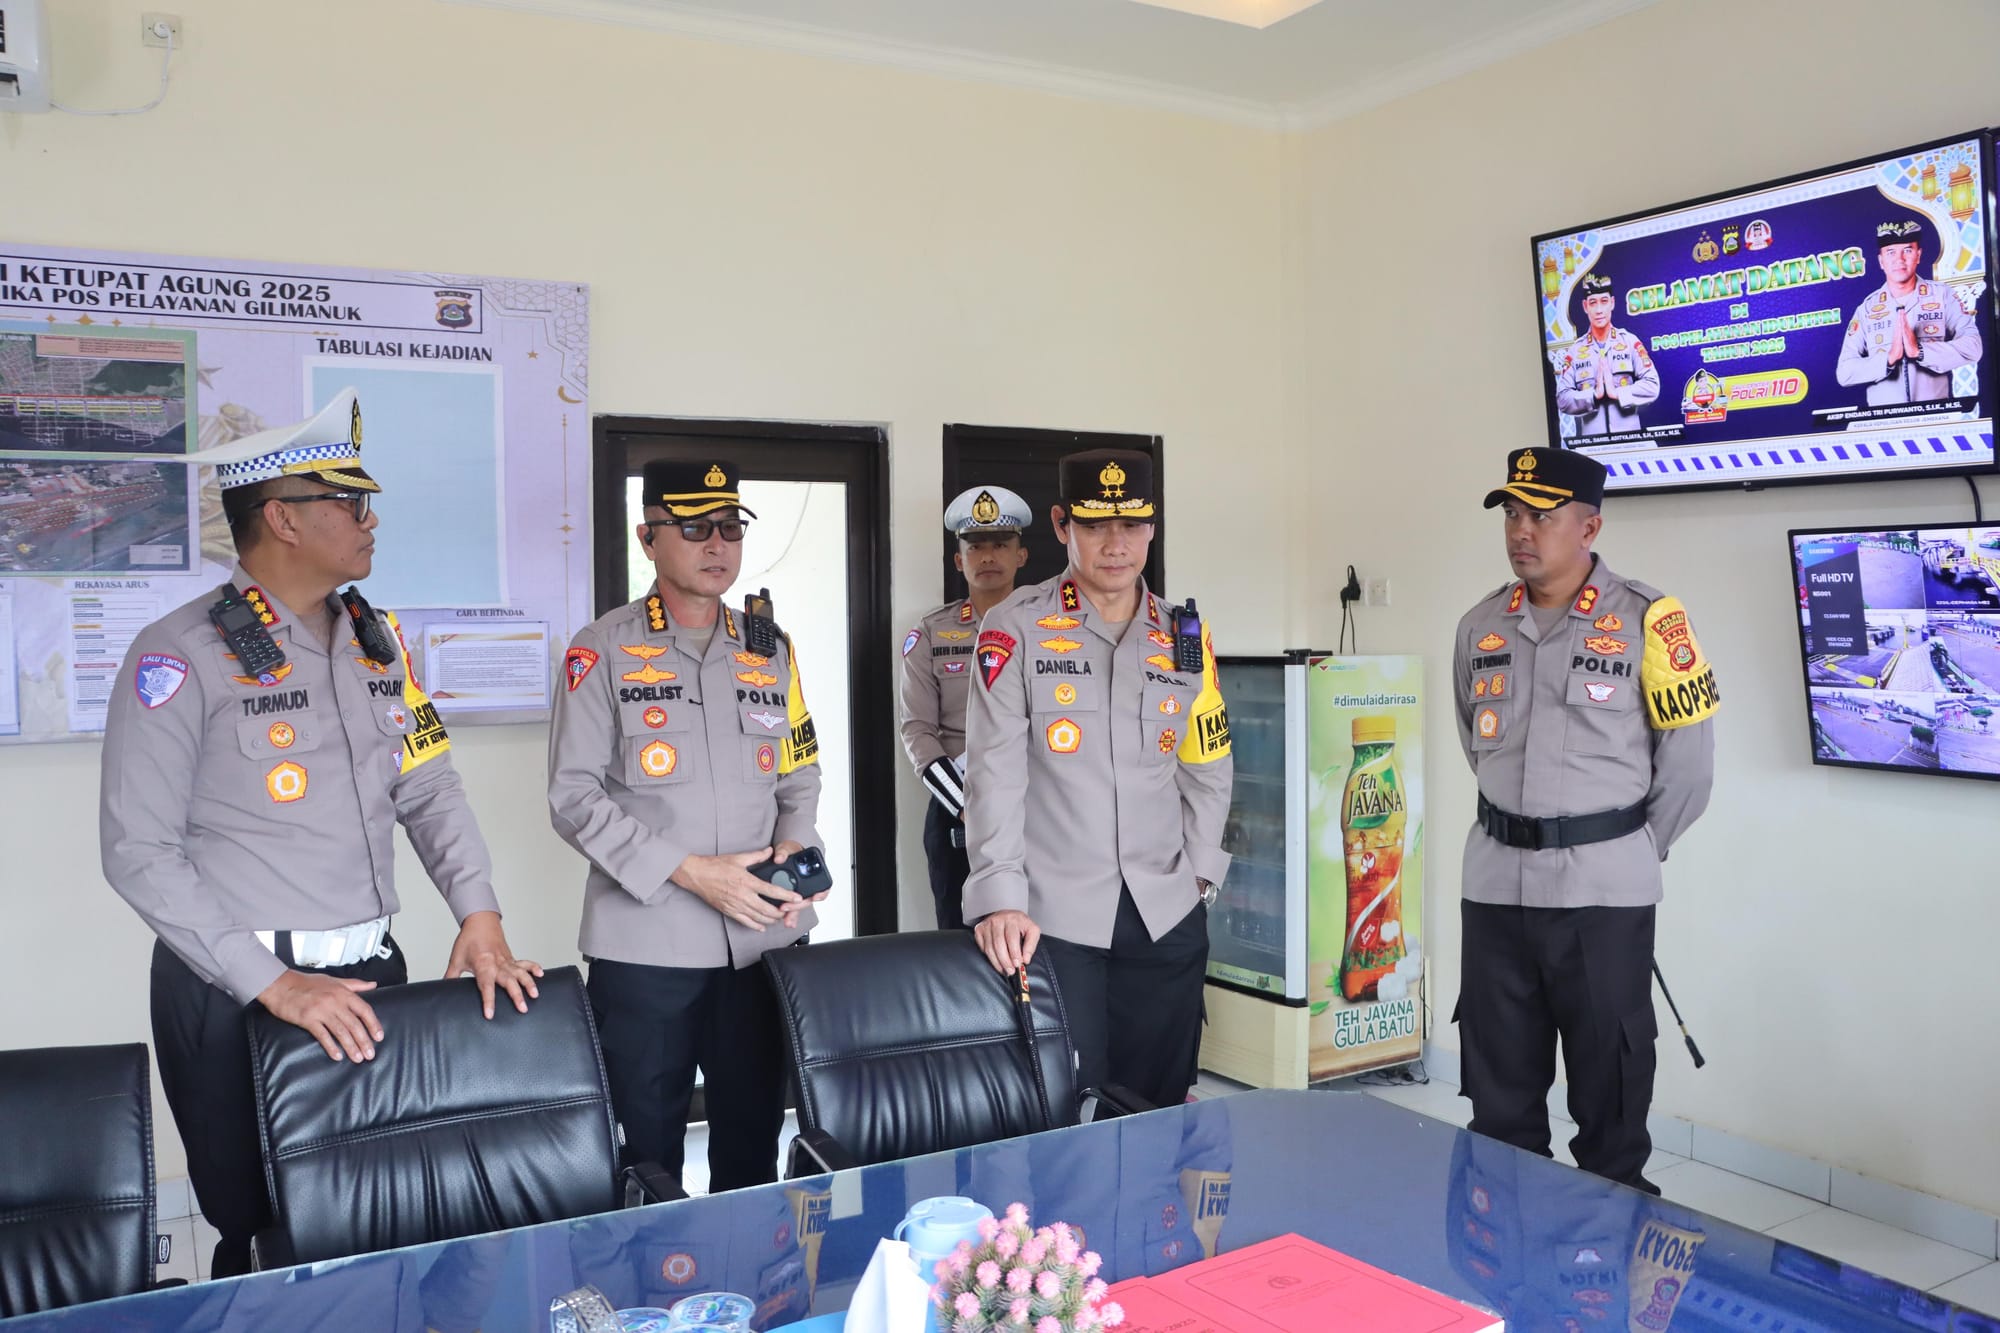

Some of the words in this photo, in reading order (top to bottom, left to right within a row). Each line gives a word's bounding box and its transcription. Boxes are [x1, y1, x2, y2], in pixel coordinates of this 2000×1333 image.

[20, 265, 149, 290] KETUPAT
[159, 275, 250, 297] AGUNG
[261, 281, 331, 302] 2025
[1627, 271, 1744, 315] SELAMAT
[1748, 248, 1865, 293] DATANG
[53, 288, 100, 306] POS
[109, 292, 236, 313] PELAYANAN
[244, 300, 362, 321] GILIMANUK
[1730, 302, 1749, 320] DI
[1917, 311, 1943, 322] POLRI
[1651, 334, 1680, 351] POS
[1680, 320, 1760, 346] PELAYANAN
[316, 338, 402, 357] TABULASI
[409, 344, 492, 362] KEJADIAN
[1701, 342, 1749, 363] TAHUN
[1751, 337, 1785, 357] 2025
[1731, 387, 1768, 400] POLRI
[1772, 378, 1799, 396] 110
[1844, 411, 1872, 419] ENDANG
[75, 581, 122, 589] REKAYASA
[125, 581, 150, 589] ARUS
[1811, 573, 1827, 583] Full
[1828, 573, 1841, 583] HD
[1841, 572, 1854, 583] TV
[456, 608, 478, 617] CARA
[480, 608, 525, 617] BERTINDAK
[142, 655, 160, 663] LALU
[162, 657, 186, 671] LINTAS
[1036, 660, 1092, 676] DANIEL.A
[1572, 655, 1632, 678] POLRI
[368, 679, 403, 698] POLRI
[620, 686, 683, 703] SOELIST
[242, 689, 309, 717] TURMUDI
[736, 689, 787, 708] POLRI
[1334, 694, 1416, 706] #dimulaidarirasa
[1357, 773, 1377, 792] Teh
[1348, 789, 1403, 825] JAVANA
[1335, 1011, 1360, 1027] TEH
[1364, 1000, 1414, 1023] JAVANA
[1334, 1023, 1375, 1048] GULA
[1380, 1016, 1414, 1040] BATU
